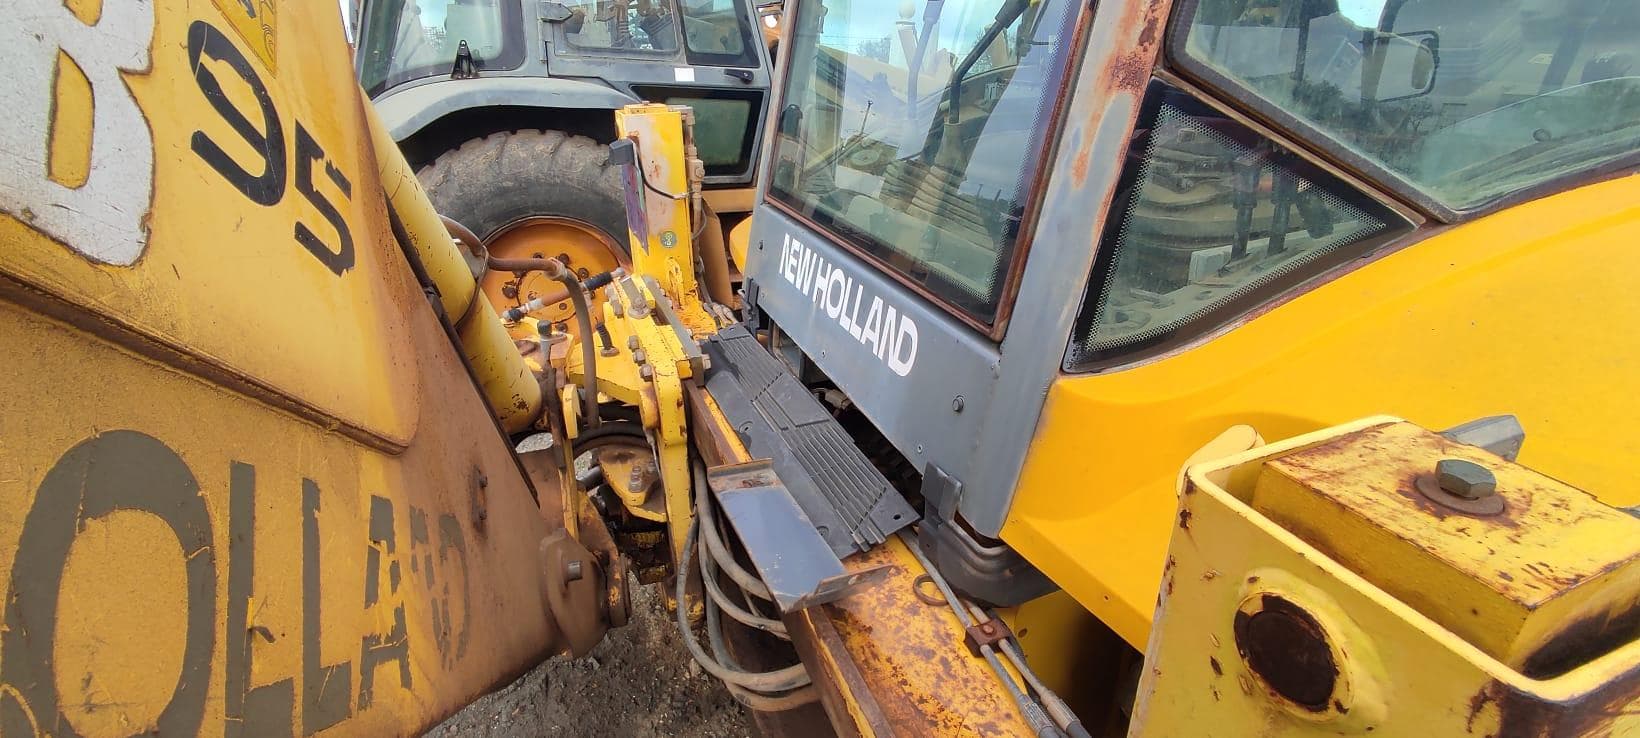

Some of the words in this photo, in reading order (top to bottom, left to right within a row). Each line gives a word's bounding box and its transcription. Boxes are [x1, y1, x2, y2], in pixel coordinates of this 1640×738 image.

[187, 20, 355, 277] 95
[779, 233, 817, 296] NEW
[812, 257, 918, 377] HOLLAND
